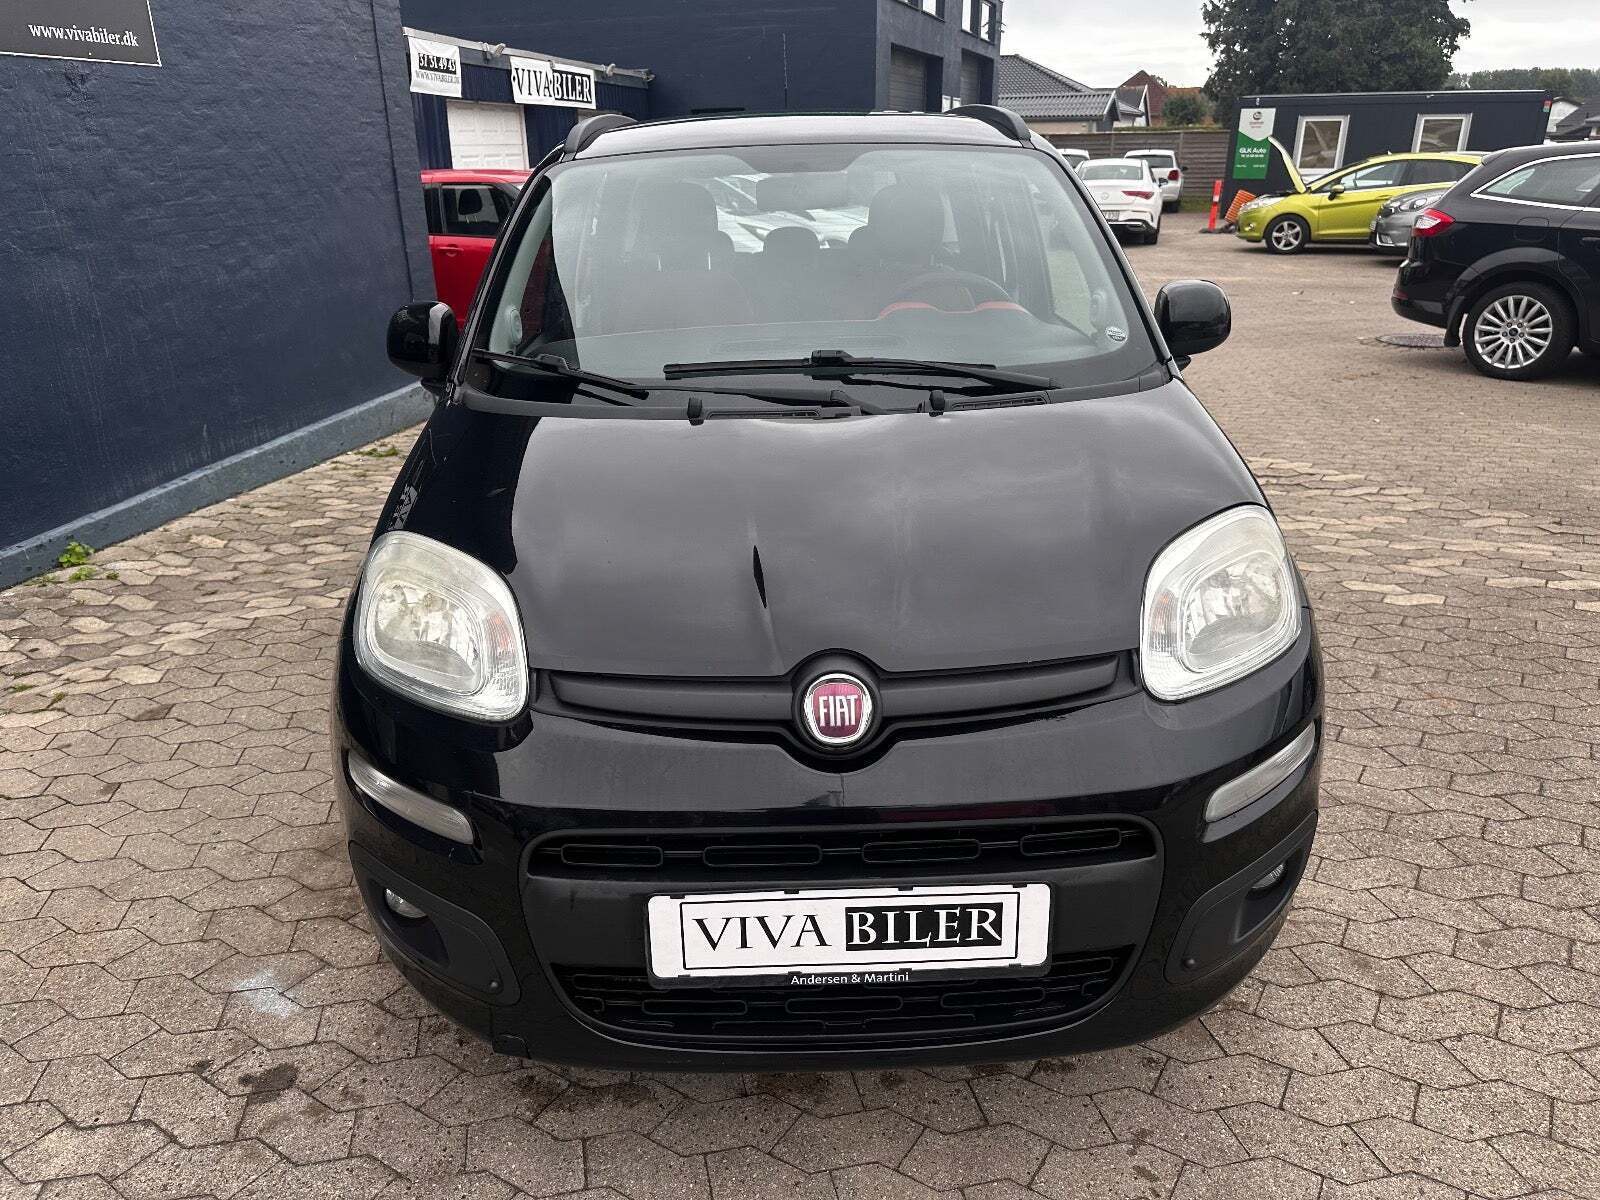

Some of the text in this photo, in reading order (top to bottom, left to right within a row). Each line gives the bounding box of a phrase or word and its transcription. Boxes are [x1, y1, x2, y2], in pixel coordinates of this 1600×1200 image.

[28, 24, 139, 47] www.vivabiler.dk
[514, 67, 592, 102] VIVA BILER
[818, 694, 858, 727] FIAT
[693, 906, 1003, 952] VIVA BILER
[791, 972, 909, 985] Andersen & Martini
